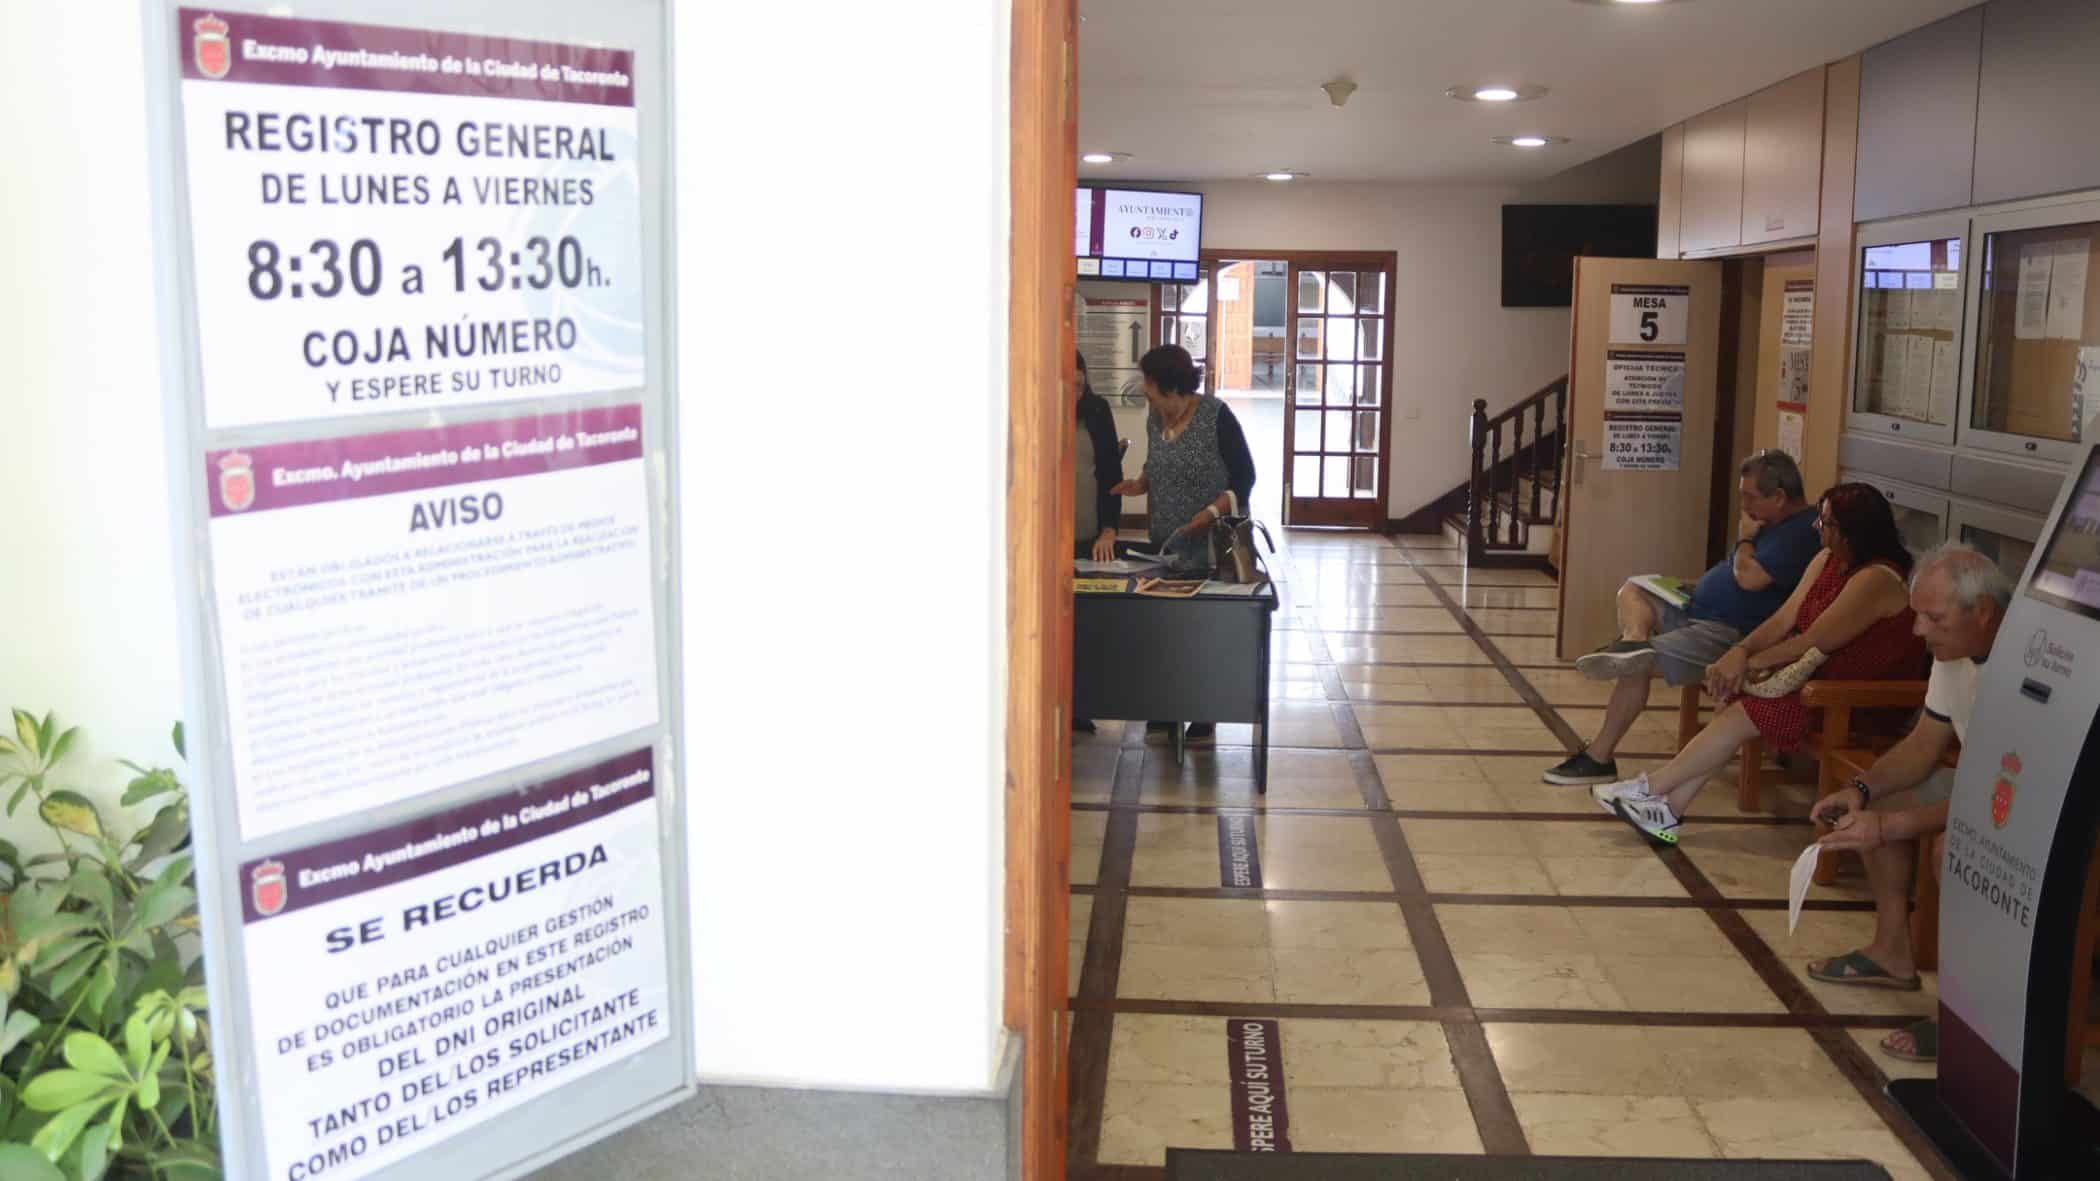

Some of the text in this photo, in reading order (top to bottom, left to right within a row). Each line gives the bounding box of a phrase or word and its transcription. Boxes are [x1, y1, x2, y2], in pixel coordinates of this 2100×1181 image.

[243, 39, 628, 87] Excmo Ayuntamiento de la Ciudad de Tacoronte
[225, 111, 615, 161] REGISTRO GENERAL
[262, 174, 594, 206] DE LUNES A VIERNES
[248, 238, 383, 300] 8:30
[401, 264, 424, 295] a
[1633, 297, 1666, 309] MESA
[1640, 312, 1659, 341] 5
[304, 314, 576, 368] COJA NÚMERO
[327, 364, 561, 403] Y ESPERE SU TURNO
[272, 426, 637, 487] Excmo. Ayuntamiento de la Ciudad de Tacoronte
[1609, 442, 1632, 453] 8:30
[410, 492, 503, 533] AVISO
[298, 769, 650, 888] Excmo Ayuntamiento de la Ciudad de Tacoronte
[326, 843, 608, 954] SE RECUERDA
[1948, 852, 2031, 928] TACORONTE
[325, 893, 614, 1010] QUE PARA CUALQUIER GESTIÓN
[278, 904, 649, 1055] DE DOCUMENTACIÓN EN ESTE REGISTRO
[307, 935, 633, 1072] ES OBLIGATORIO LA PRESENTACIÓN
[378, 983, 585, 1078] DEL DNI ORIGINAL
[1243, 1022, 1267, 1063] TURNO
[308, 987, 640, 1139] TANTO DEL/LOS SOLICITANTE
[1246, 1064, 1269, 1079] SU
[288, 1008, 657, 1181] COMO DEL/LOS REPRESENTANTE
[1240, 1081, 1275, 1114] AQUÍ
